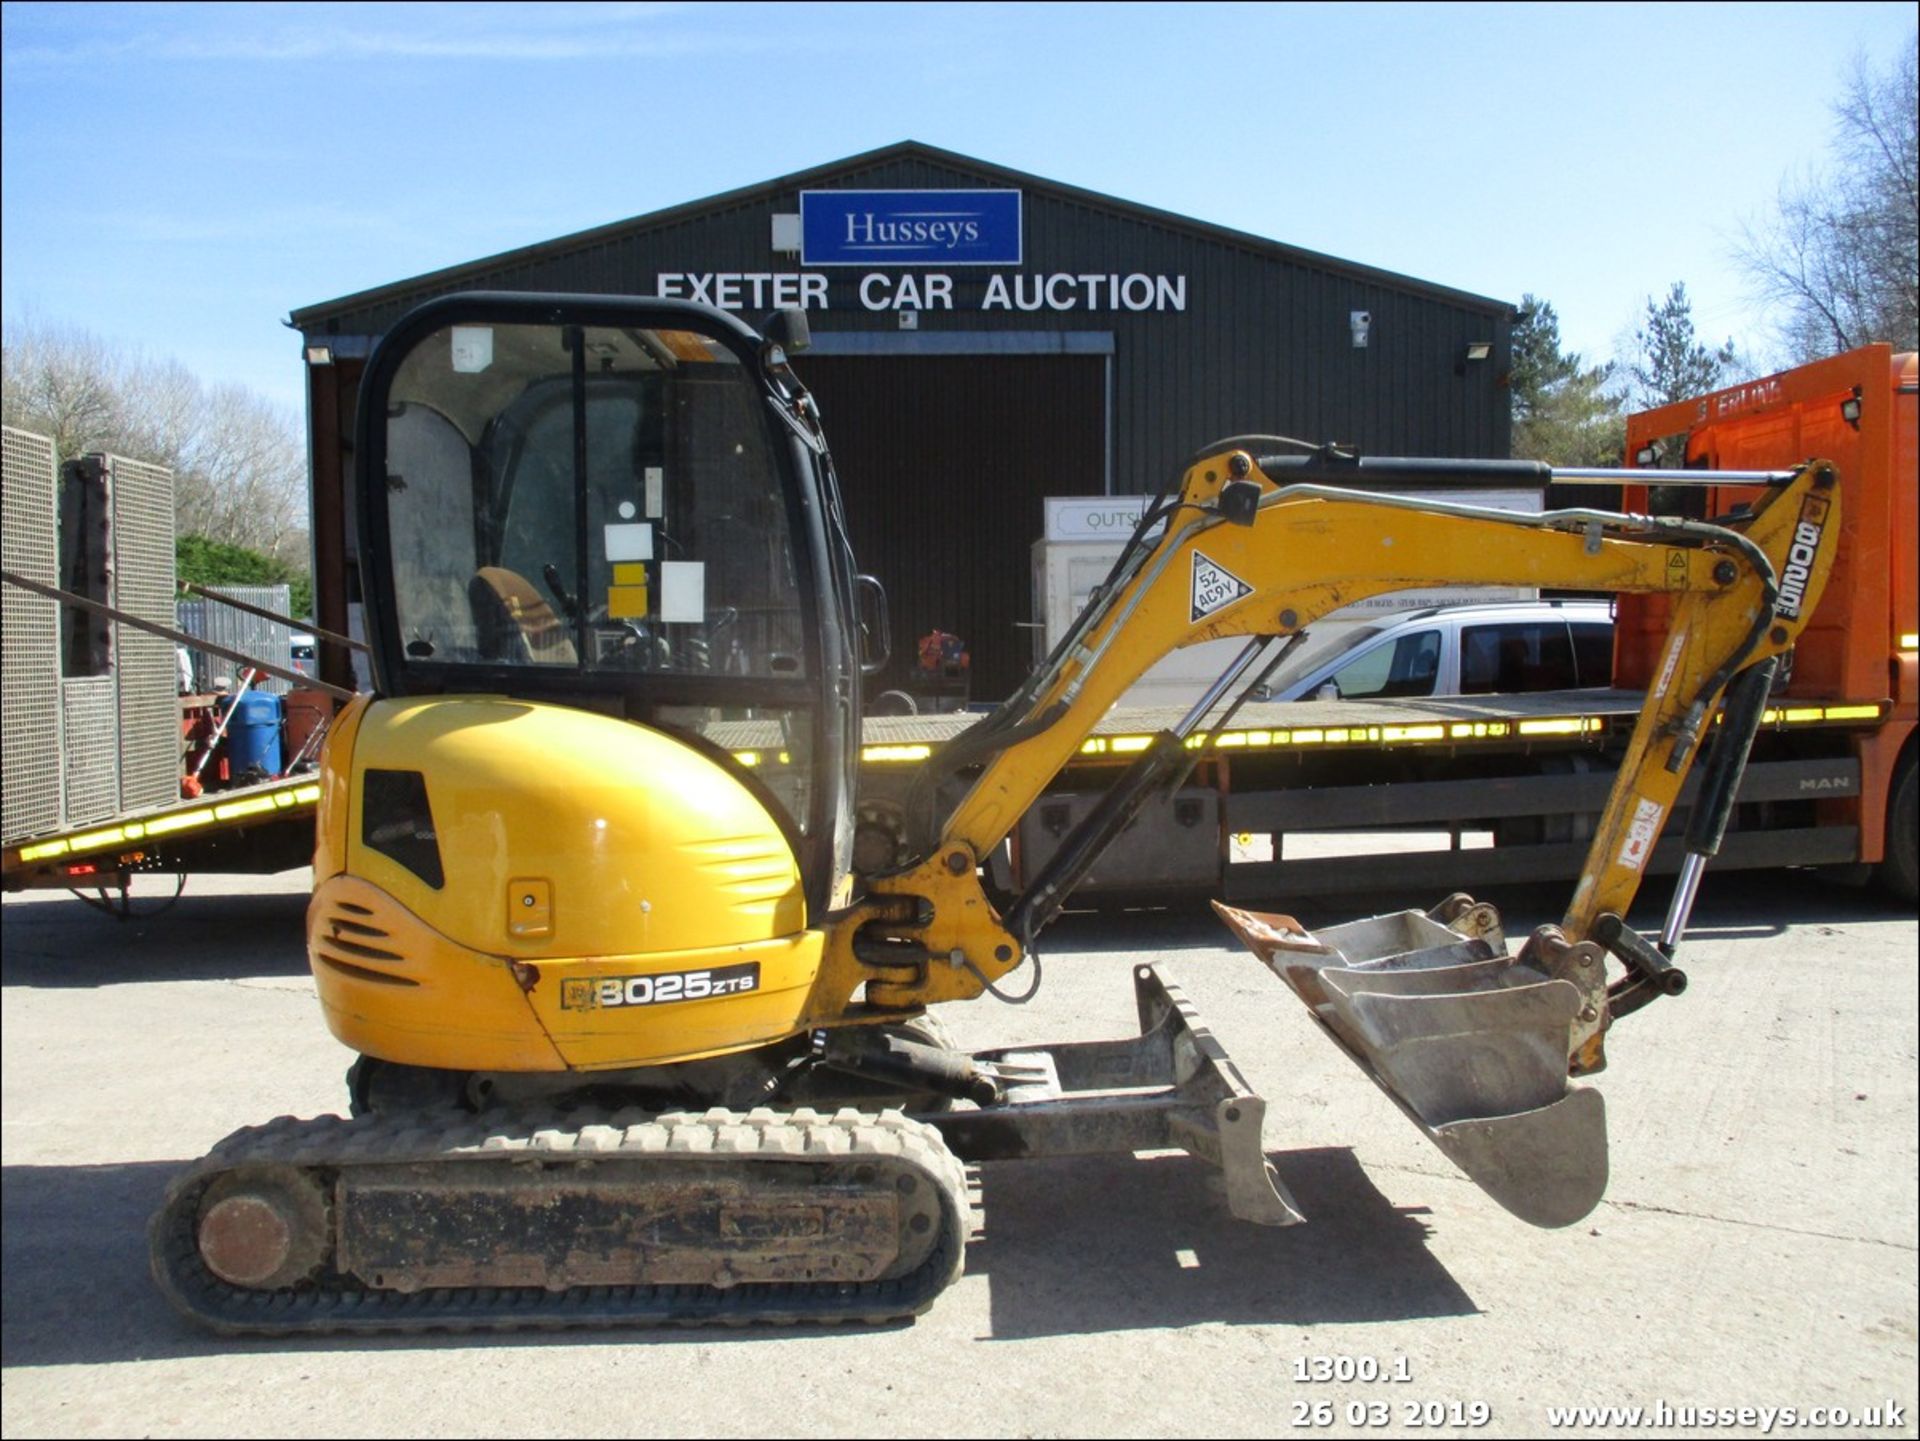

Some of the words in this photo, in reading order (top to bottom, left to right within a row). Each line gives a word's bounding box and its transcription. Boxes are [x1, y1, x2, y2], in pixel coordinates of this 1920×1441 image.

[845, 212, 979, 249] Husseys
[657, 272, 829, 309] EXETER
[859, 272, 953, 310] CAR
[982, 272, 1187, 311] AUCTION
[1199, 570, 1219, 588] 52
[1199, 580, 1232, 607] AC9Y
[1800, 776, 1849, 790] MAN
